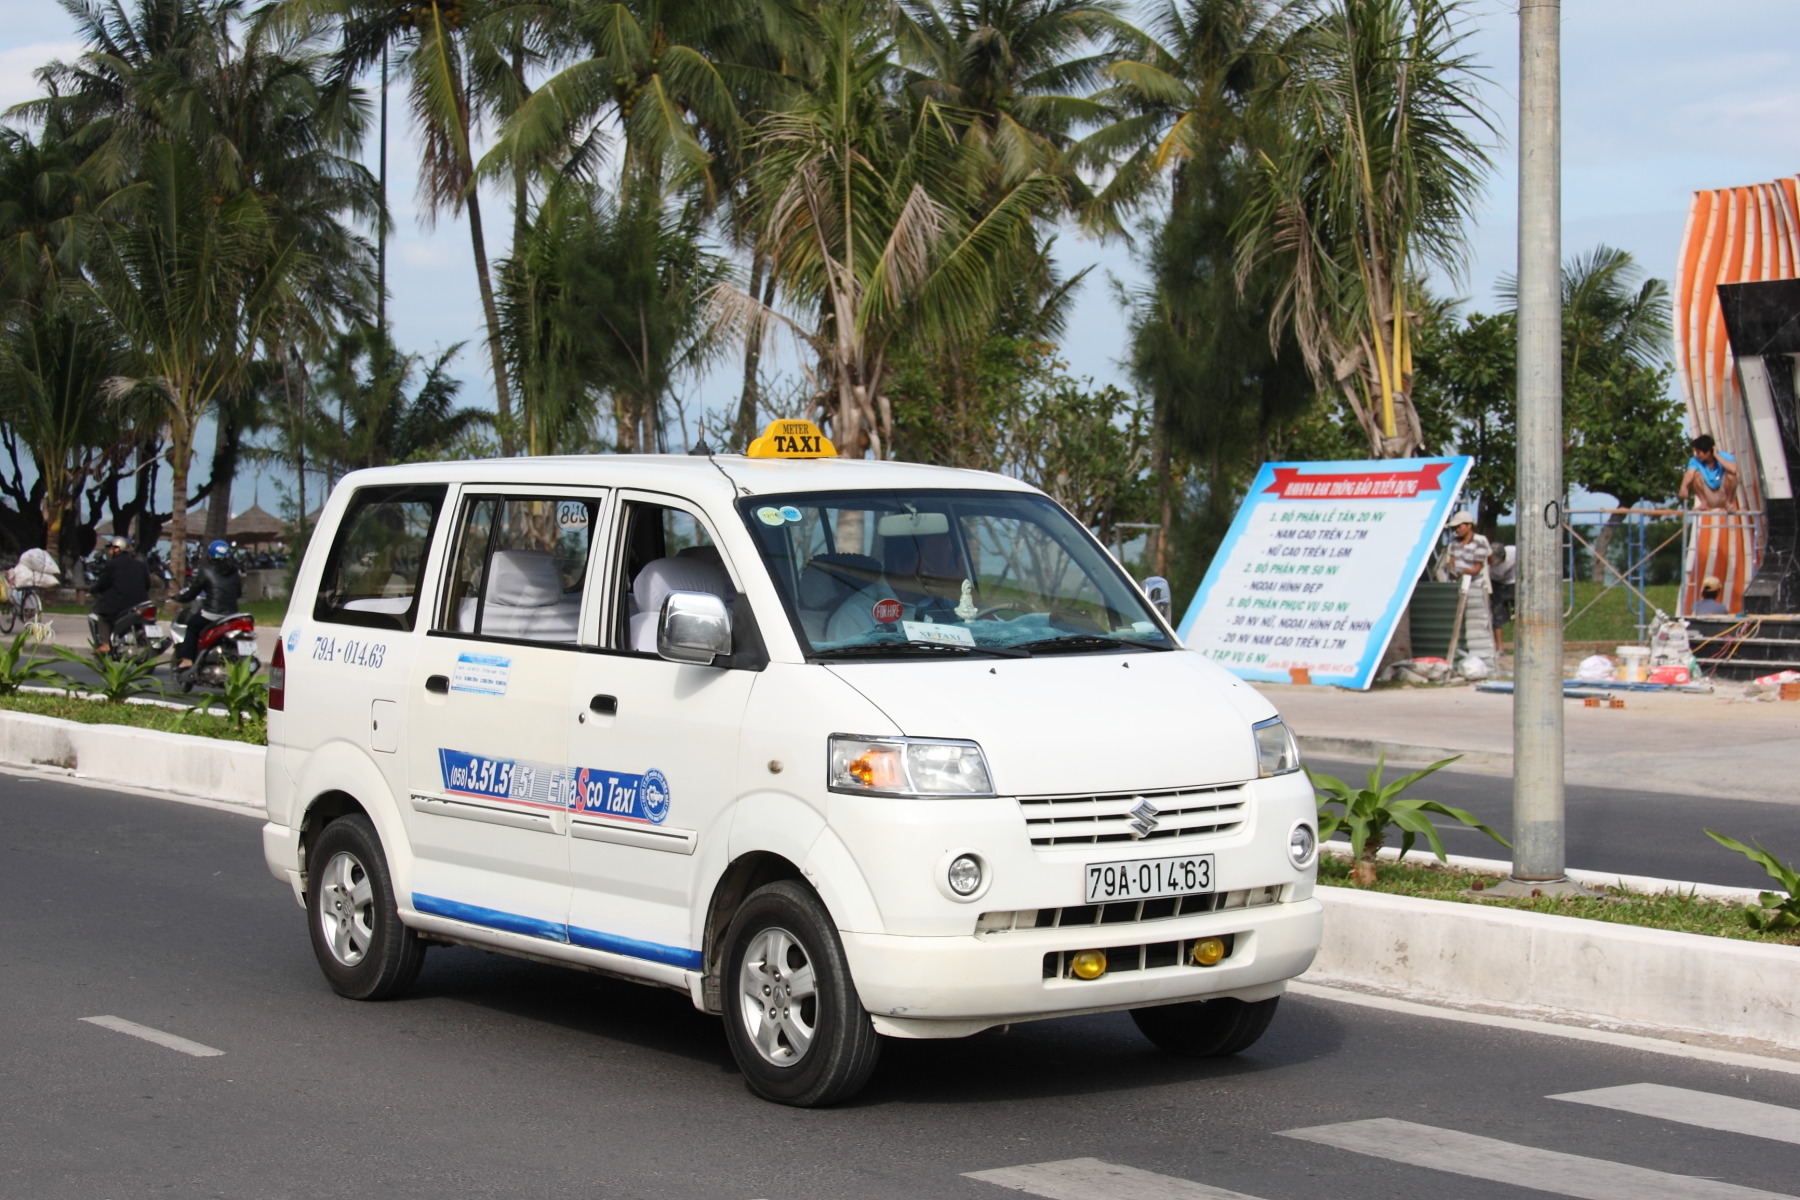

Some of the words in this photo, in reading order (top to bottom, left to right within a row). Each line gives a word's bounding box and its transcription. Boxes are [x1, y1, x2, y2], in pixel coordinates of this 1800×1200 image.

[783, 424, 808, 434] METER
[774, 436, 821, 452] TAXI
[1357, 512, 1370, 522] 20
[1371, 512, 1386, 522] NV
[1275, 530, 1296, 540] NAM
[1297, 530, 1316, 540] CAO
[1344, 530, 1368, 540] 1.7M
[1282, 548, 1300, 556] CAO
[1329, 548, 1352, 558] 1.6M
[1296, 564, 1310, 574] PR
[1312, 565, 1324, 575] 50
[1325, 566, 1340, 575] NV
[888, 604, 900, 618] HIRE
[1321, 602, 1335, 612] 50
[1336, 602, 1351, 612] NV
[1232, 616, 1246, 626] 30
[1247, 616, 1261, 626] NV
[936, 632, 962, 641] TAXI
[1224, 633, 1236, 643] 20
[1238, 634, 1252, 644] NV
[1251, 636, 1274, 646] NAM
[1274, 636, 1294, 646] CAO
[1322, 639, 1347, 649] 1.7M
[1246, 653, 1254, 662] 6
[1256, 654, 1270, 664] NV
[606, 777, 638, 814] Taxi
[1090, 860, 1210, 898] 79A-014.63
